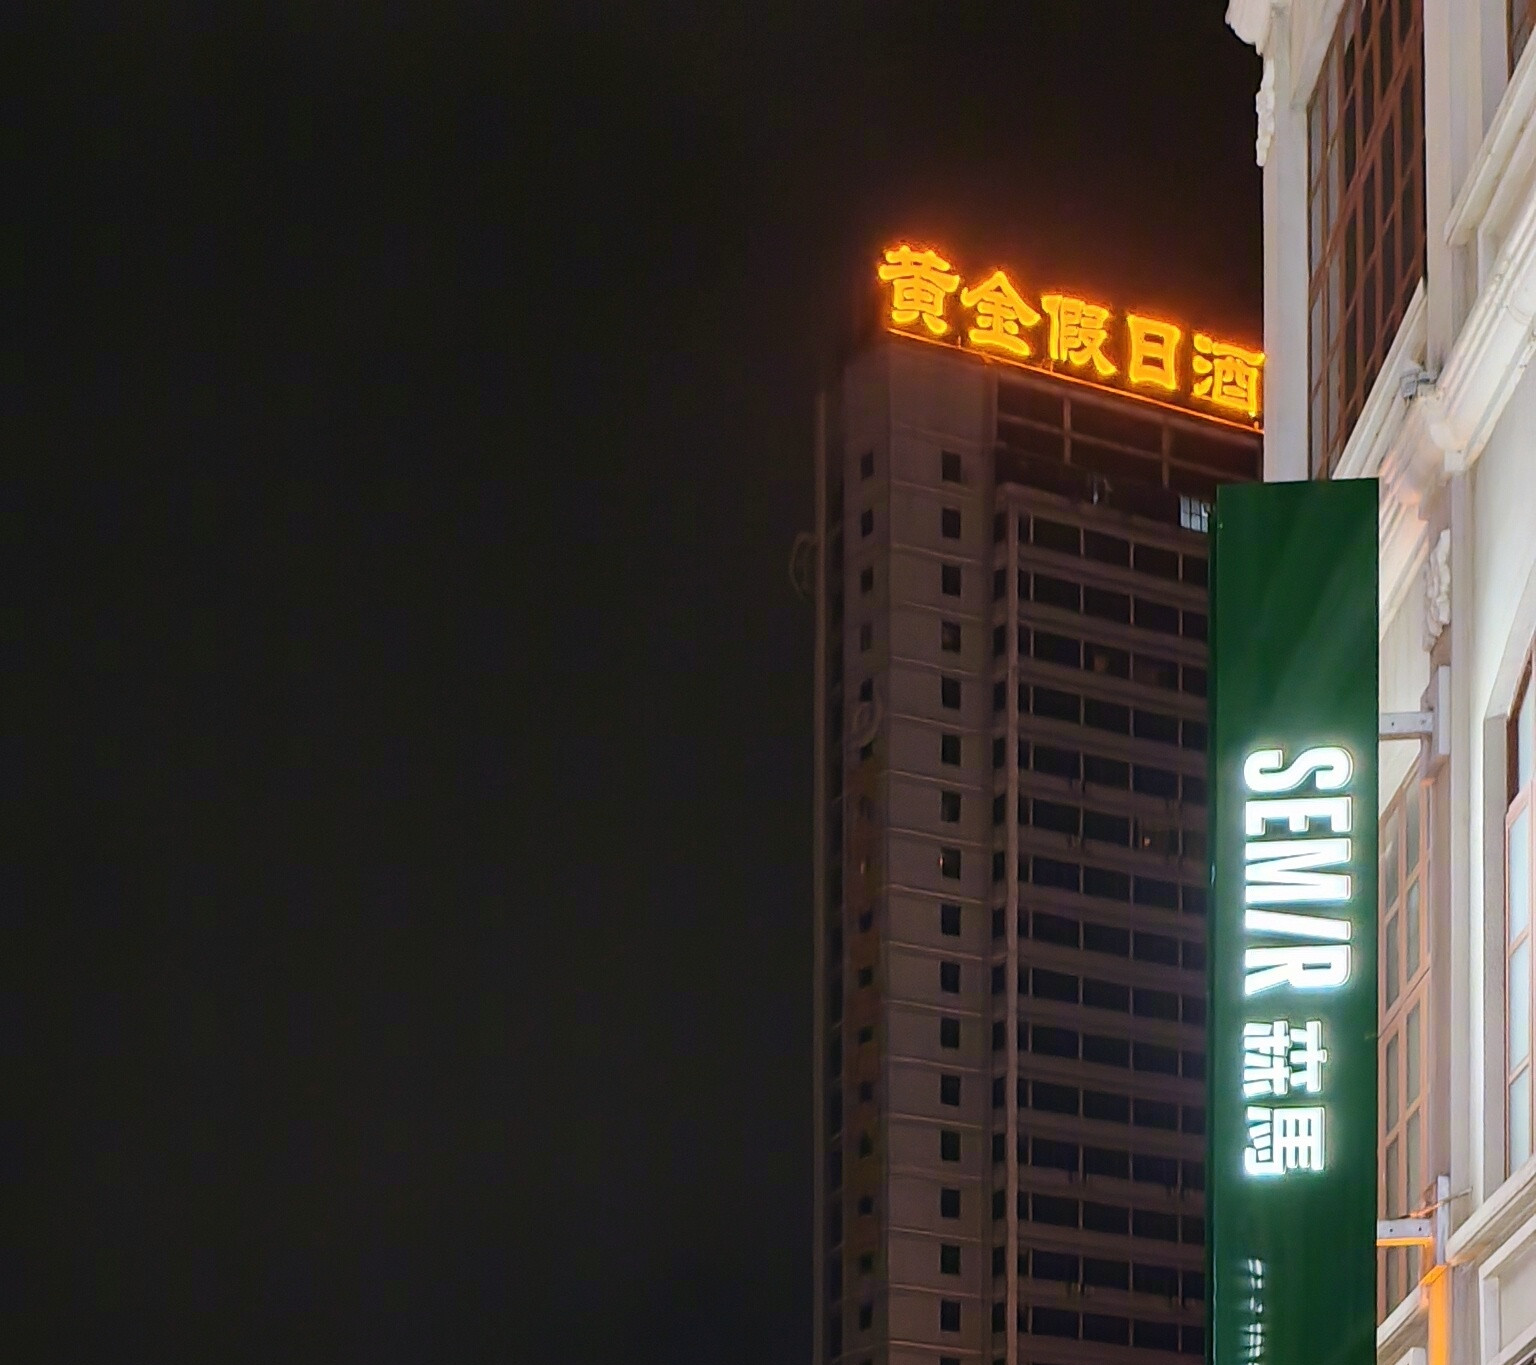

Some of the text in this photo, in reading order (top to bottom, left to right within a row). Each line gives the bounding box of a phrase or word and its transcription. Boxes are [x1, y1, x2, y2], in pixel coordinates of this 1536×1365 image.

[877, 243, 1264, 418] 黄金假日酒
[1243, 746, 1353, 996] SEMIR
